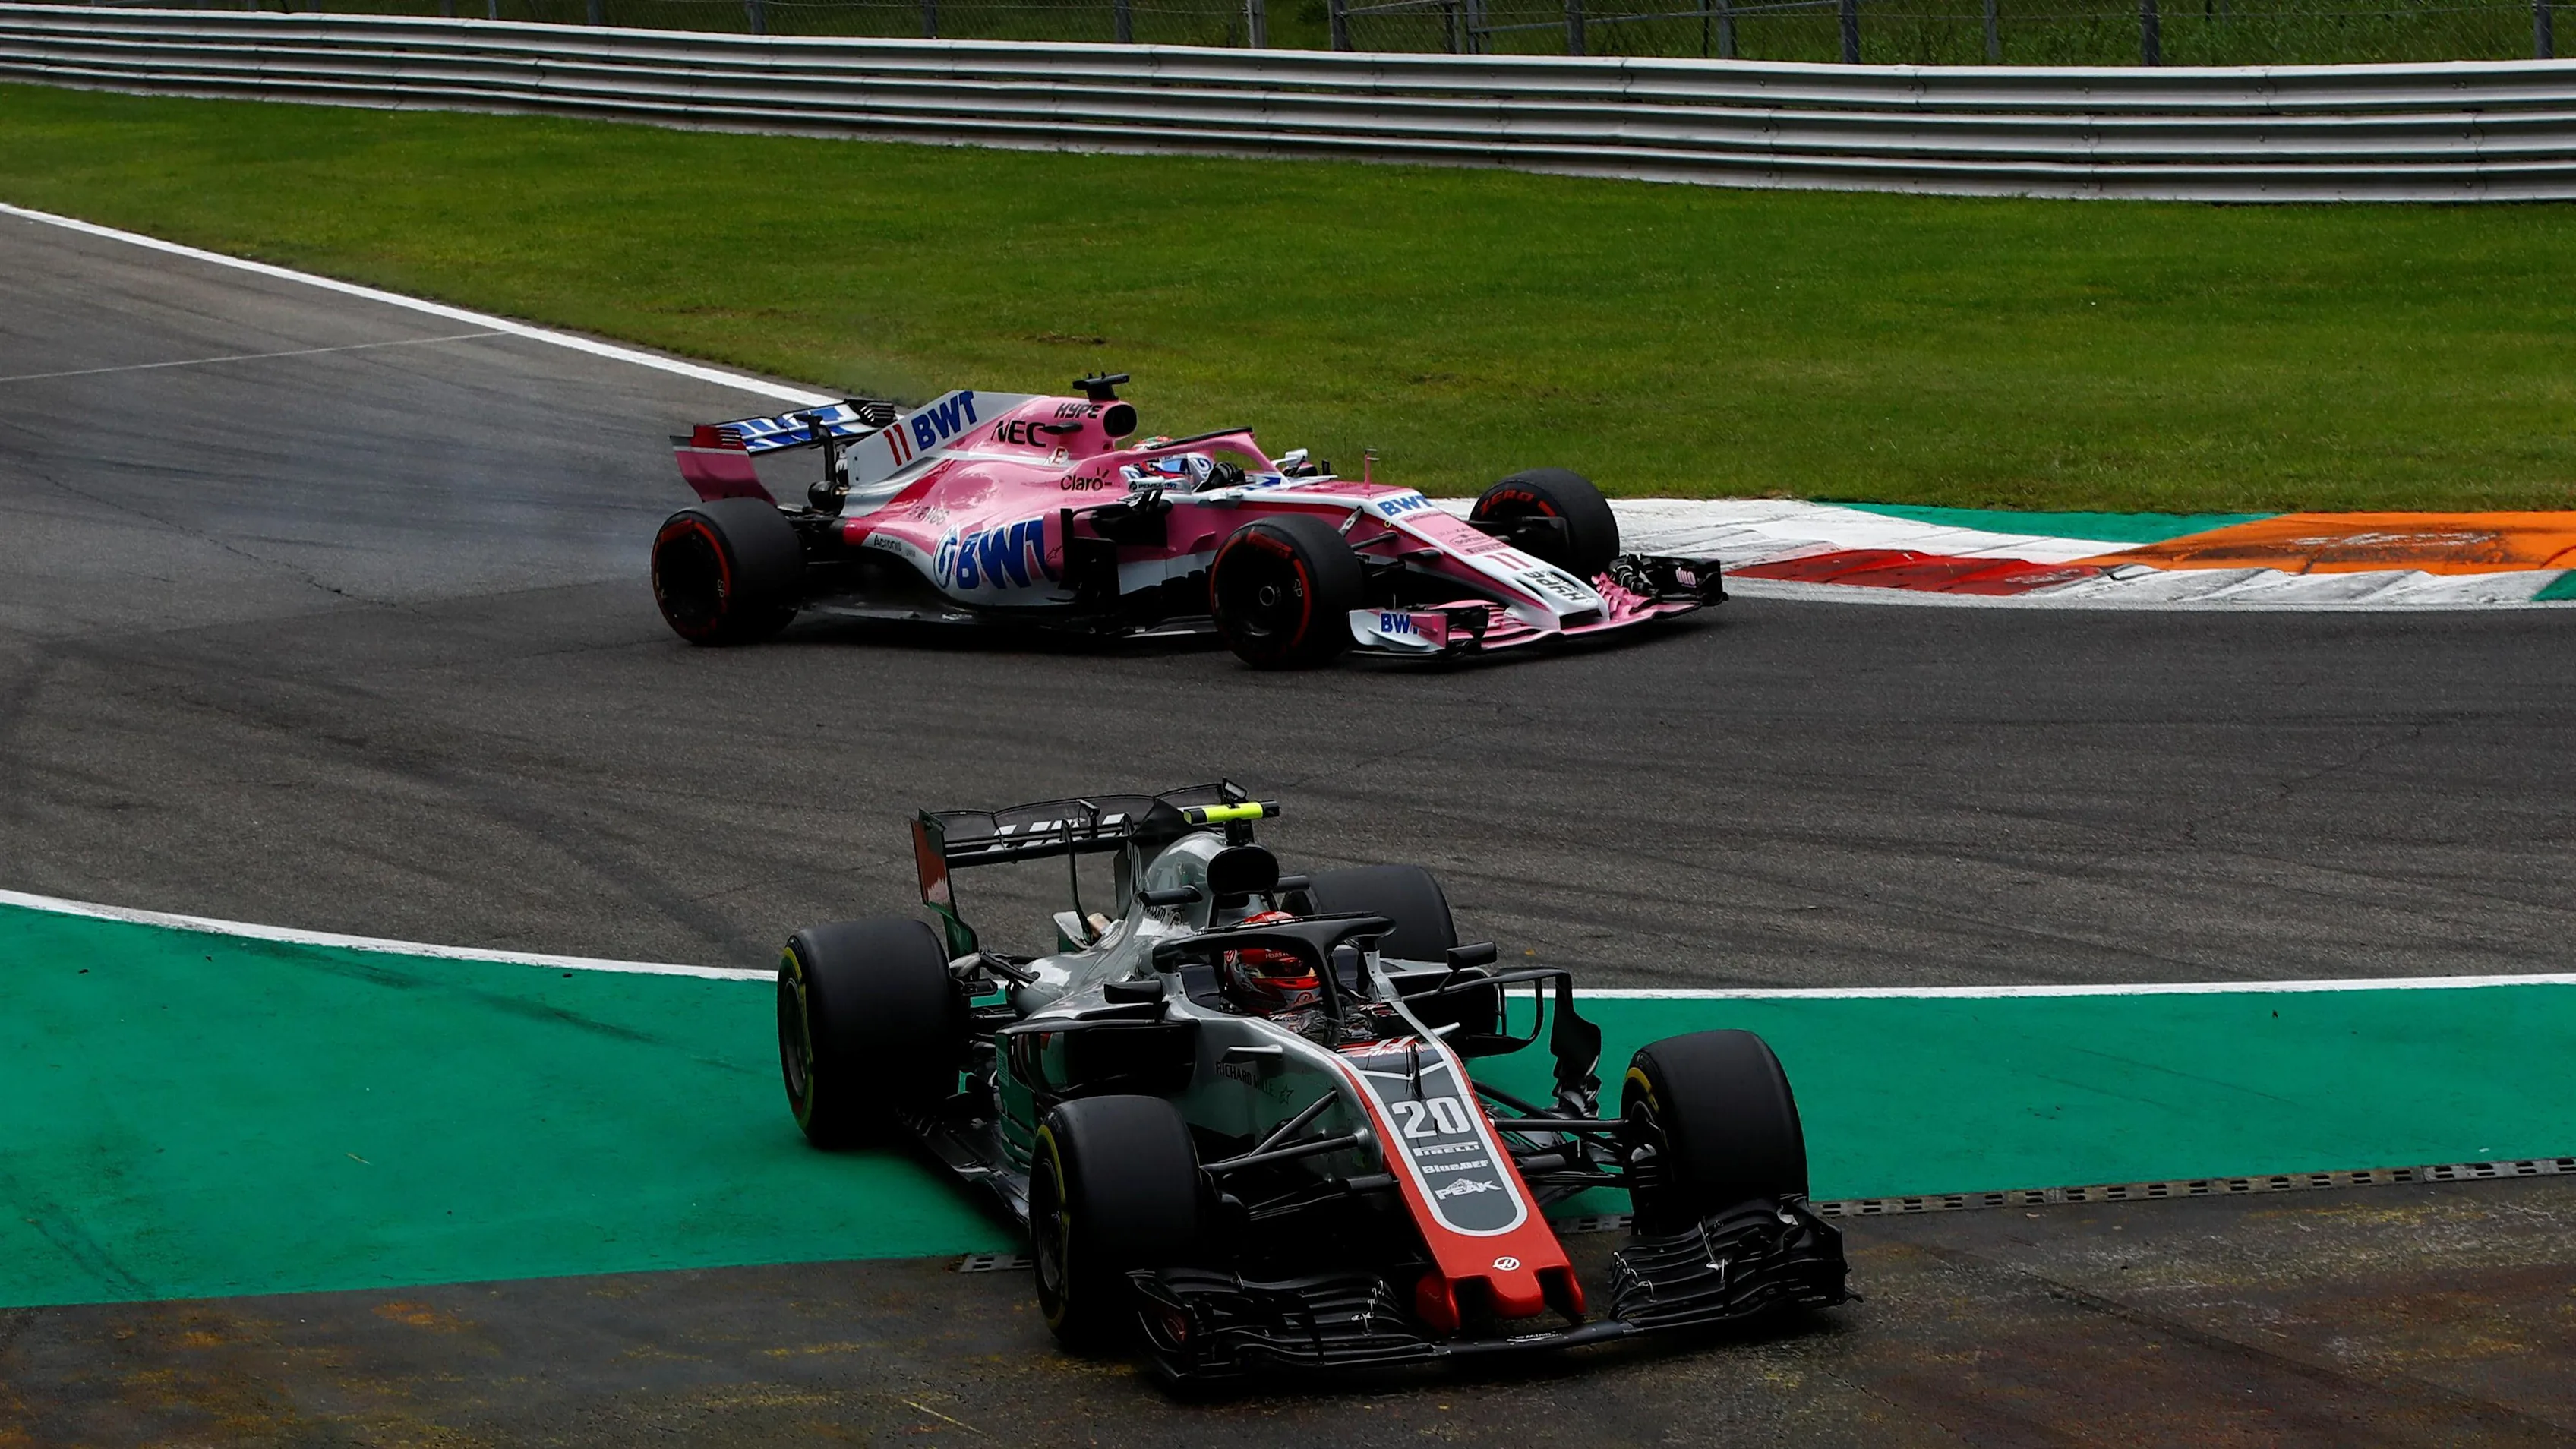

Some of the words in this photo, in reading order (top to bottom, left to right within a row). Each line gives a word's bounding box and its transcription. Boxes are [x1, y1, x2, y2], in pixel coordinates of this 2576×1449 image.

[911, 390, 977, 451] BWT
[1054, 403, 1104, 419] HYPE
[883, 424, 912, 466] 11
[990, 420, 1047, 447] NEC
[1061, 471, 1107, 491] Claro
[1377, 495, 1432, 516] BWT
[956, 519, 1060, 589] BWT
[1483, 552, 1533, 571] 11
[1215, 1061, 1253, 1086] RICHARD
[1391, 1097, 1472, 1139] 20
[1413, 1141, 1481, 1157] PIRELLI
[1435, 1179, 1502, 1200] PEAK
